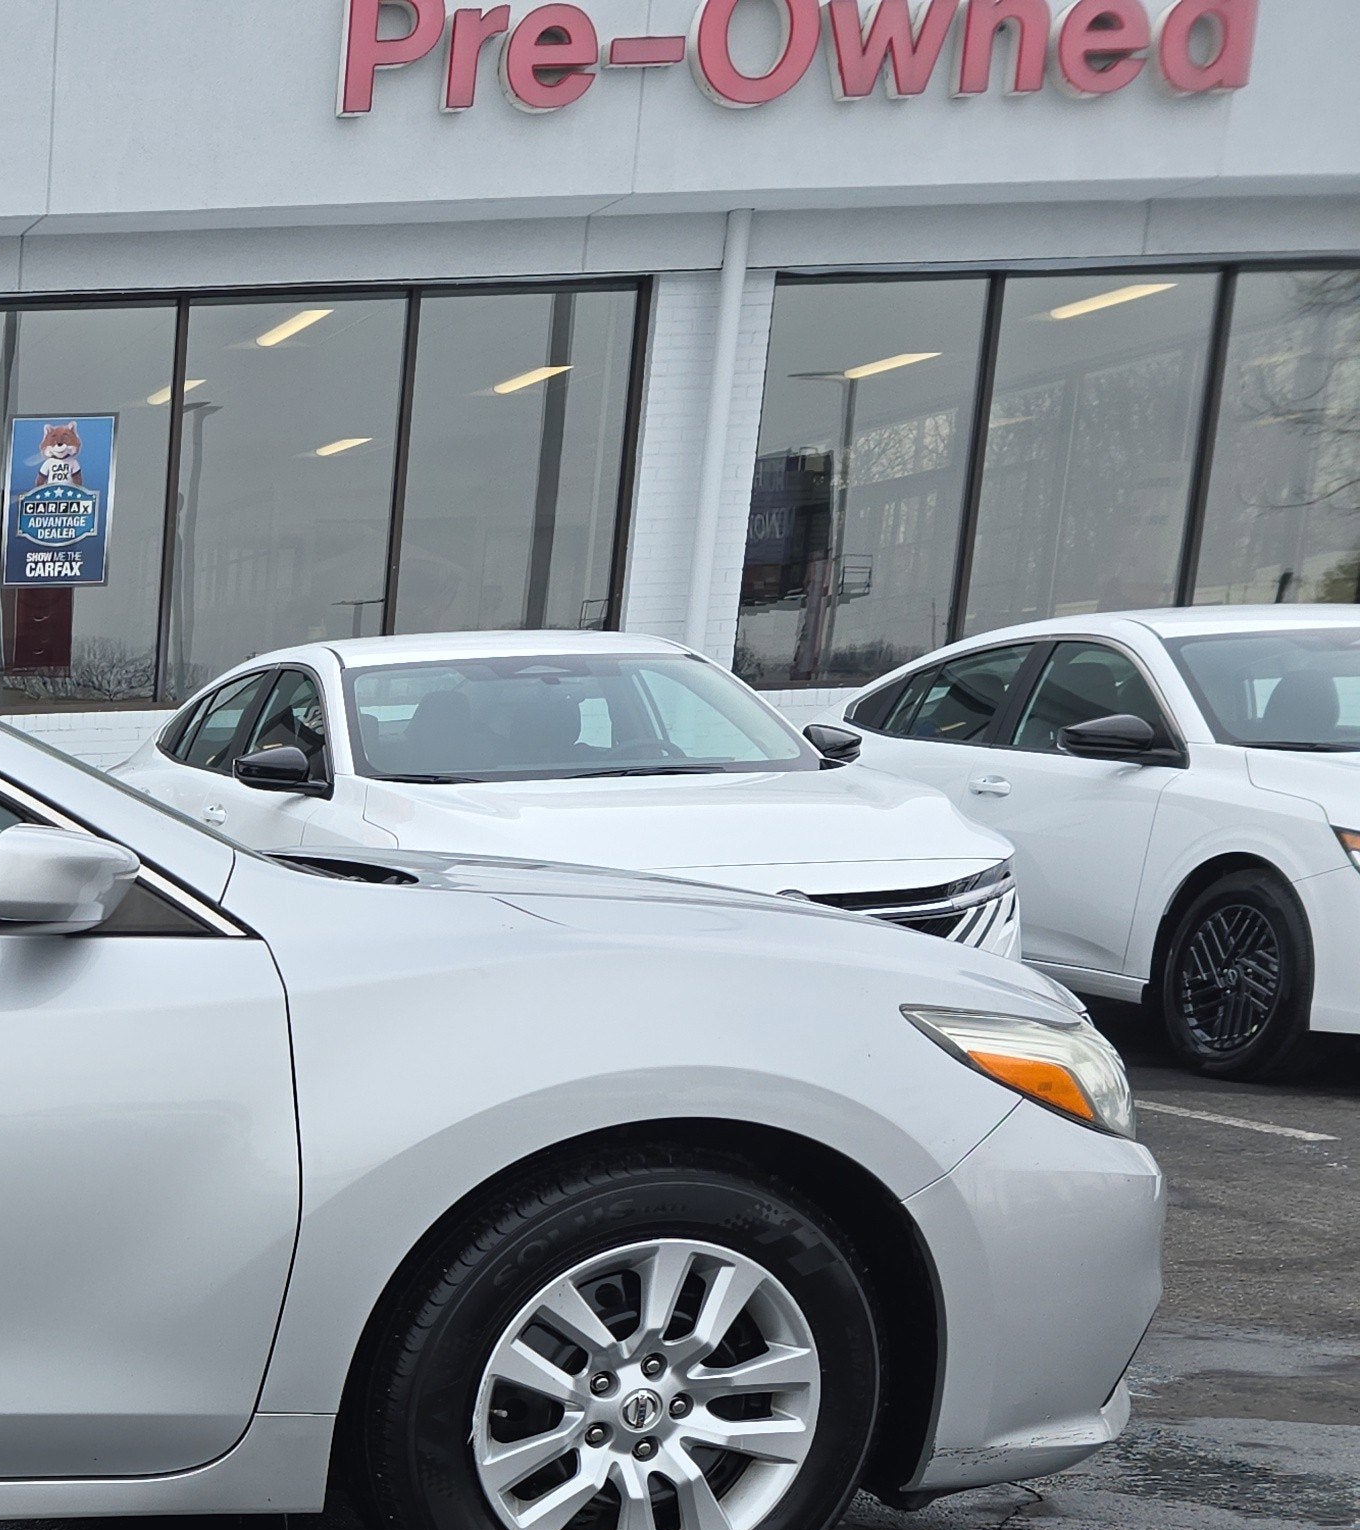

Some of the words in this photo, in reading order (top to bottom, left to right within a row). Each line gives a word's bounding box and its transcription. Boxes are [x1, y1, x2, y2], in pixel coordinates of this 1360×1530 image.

[51, 464, 69, 473] CAR
[52, 472, 69, 481] FOX
[25, 501, 92, 515] CARFAX
[28, 516, 86, 528] ADVANTAGE
[37, 528, 76, 539] DEALER
[26, 552, 52, 562] SHOW
[53, 552, 66, 562] ME
[67, 551, 82, 562] THE
[25, 562, 82, 577] CARFAX
[493, 1198, 634, 1289] SOLUS
